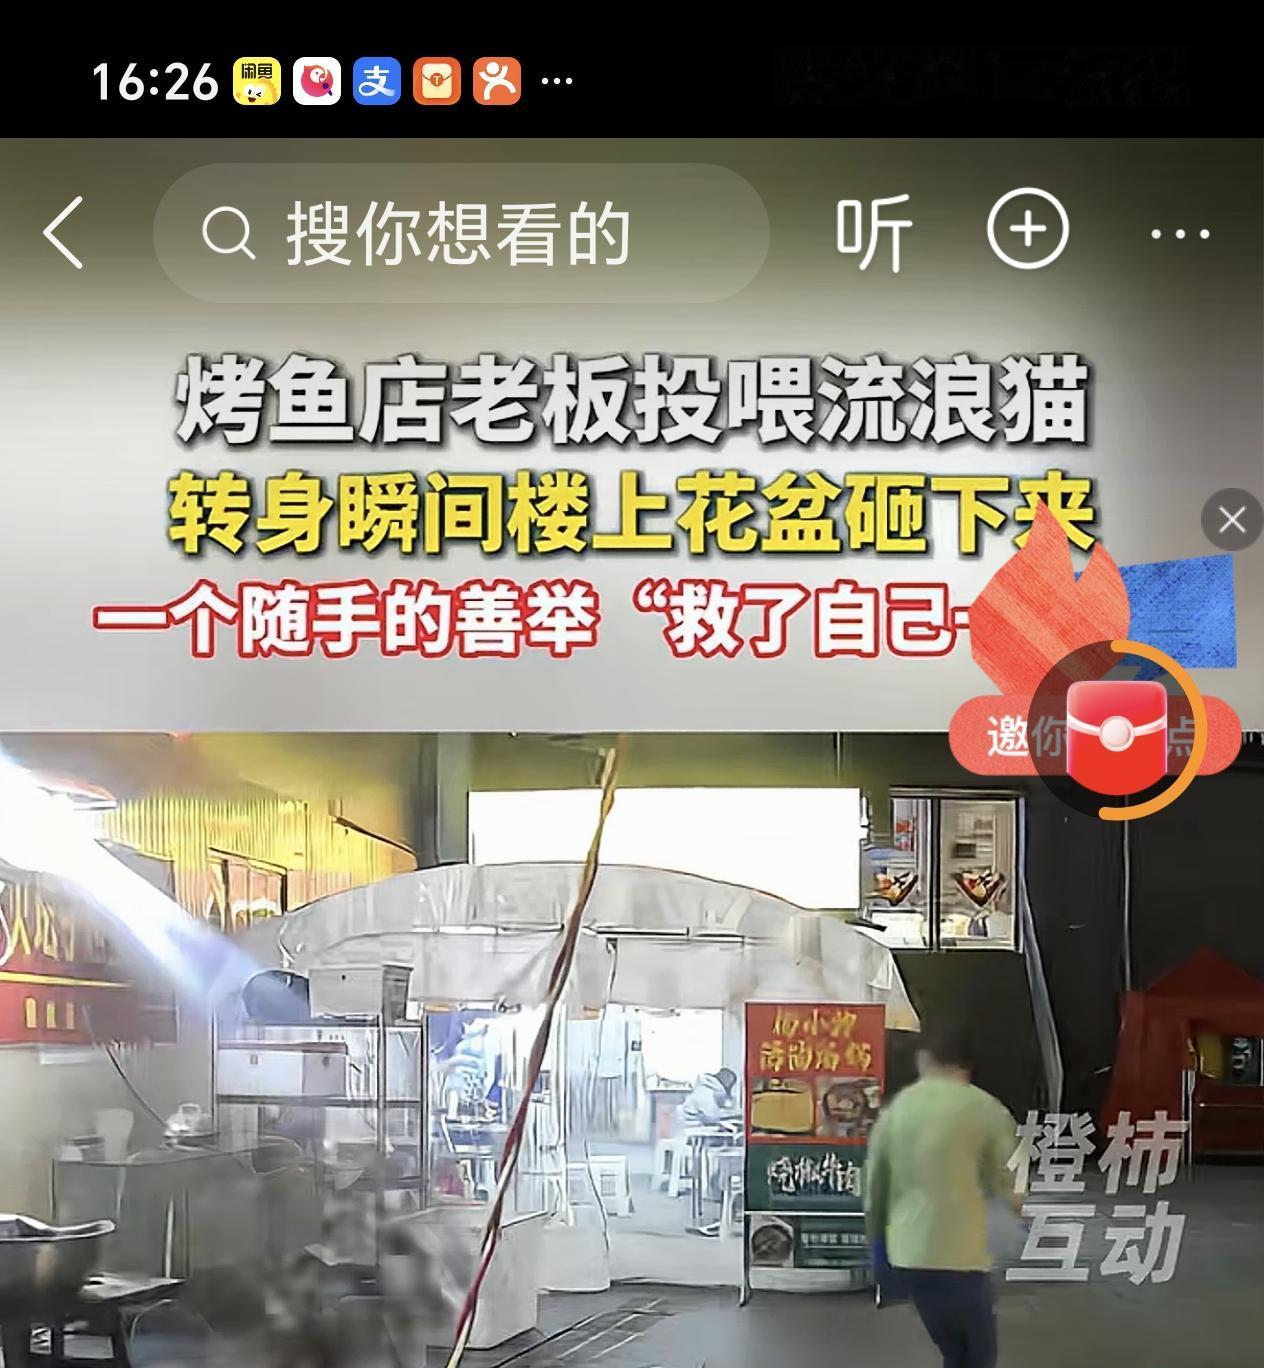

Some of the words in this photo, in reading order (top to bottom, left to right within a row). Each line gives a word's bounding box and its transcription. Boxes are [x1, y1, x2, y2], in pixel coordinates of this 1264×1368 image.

[92, 61, 219, 101] 16:26
[240, 63, 273, 80] 闲鱼
[285, 200, 630, 268] 搜你想看的
[836, 194, 914, 274] 听
